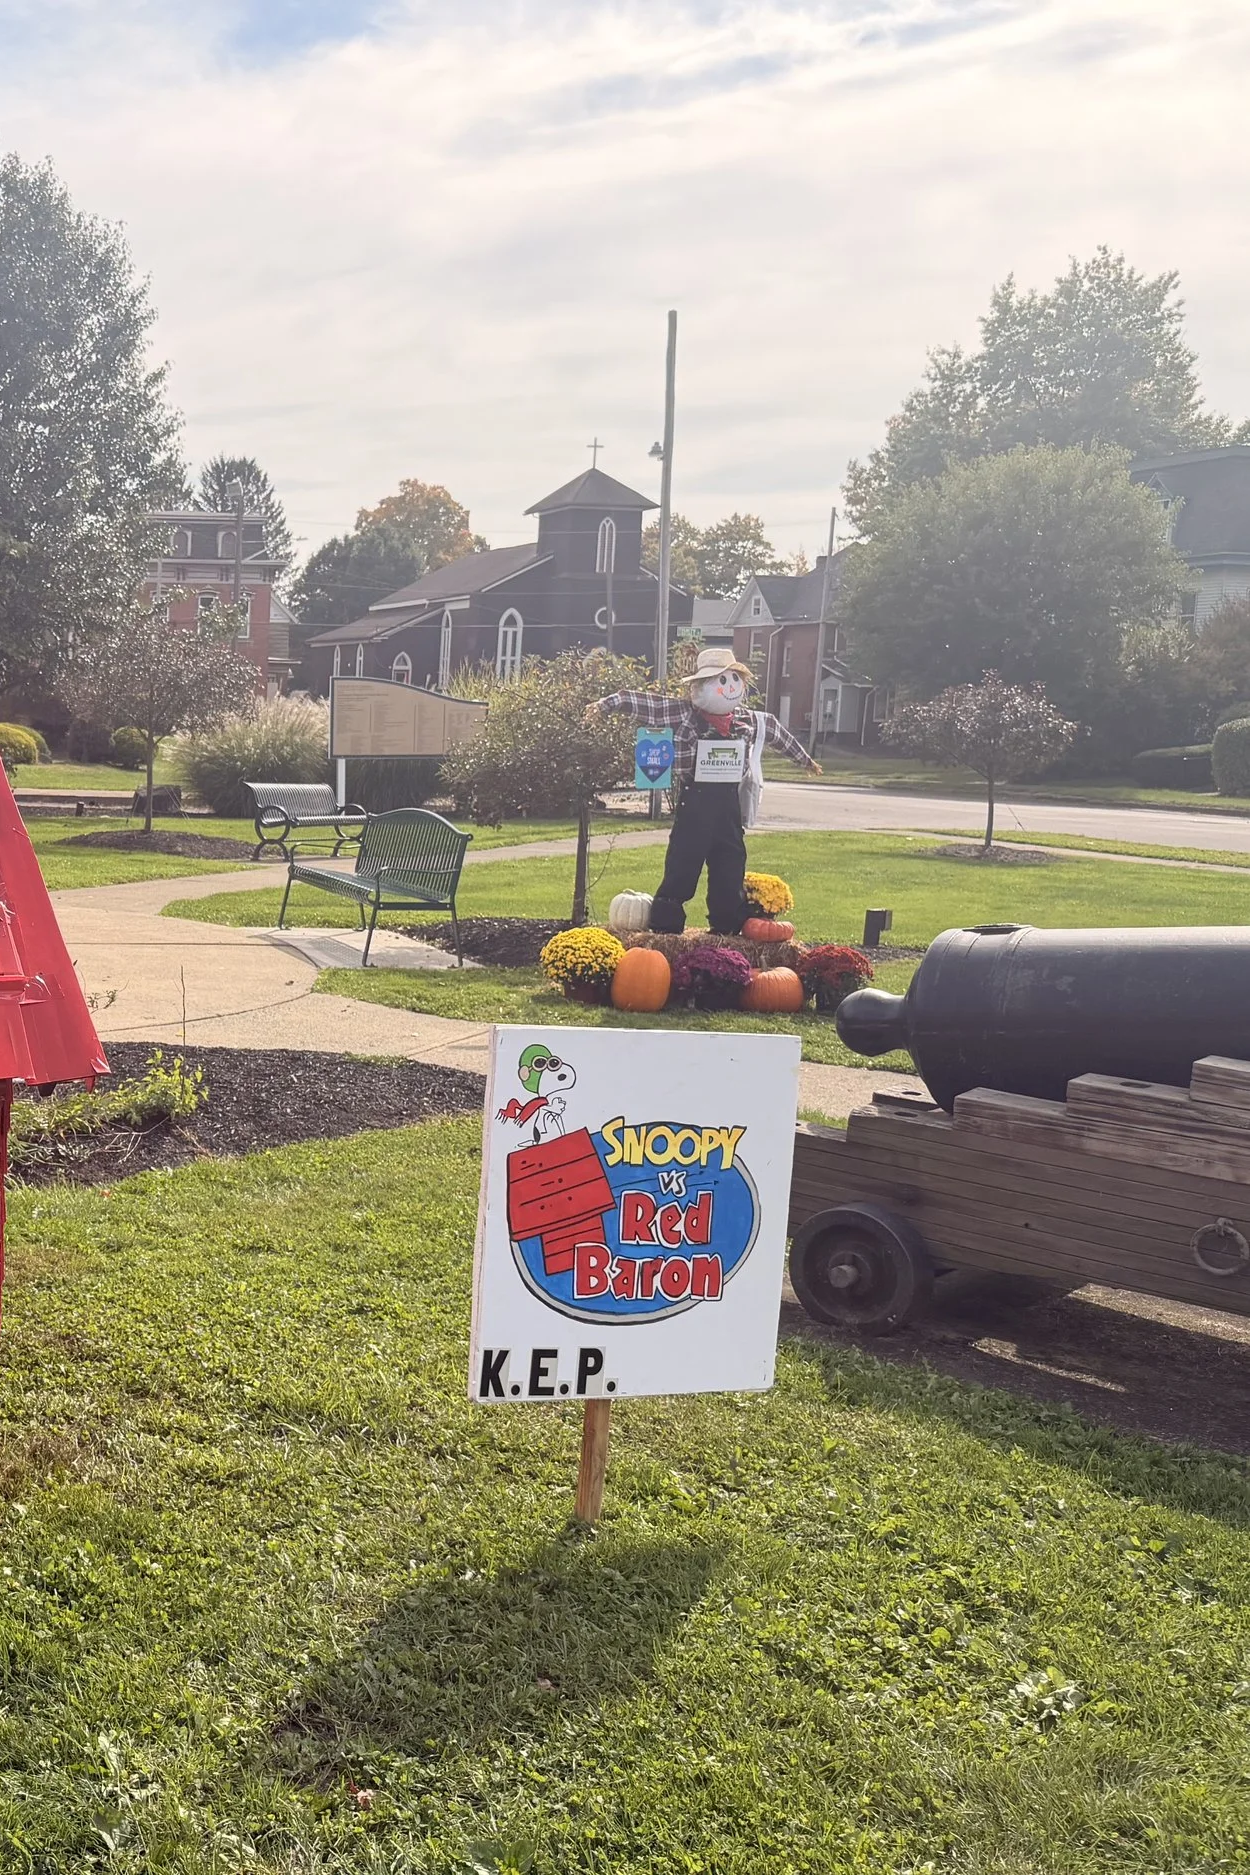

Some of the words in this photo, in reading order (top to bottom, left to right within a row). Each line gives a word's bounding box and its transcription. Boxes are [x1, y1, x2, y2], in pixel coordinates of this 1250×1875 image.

[700, 759, 742, 767] GREENVILLE
[601, 1116, 747, 1171] SNOOPY
[619, 1190, 714, 1249] Red
[573, 1242, 725, 1301] Baron
[479, 1347, 617, 1398] K.E.P.
